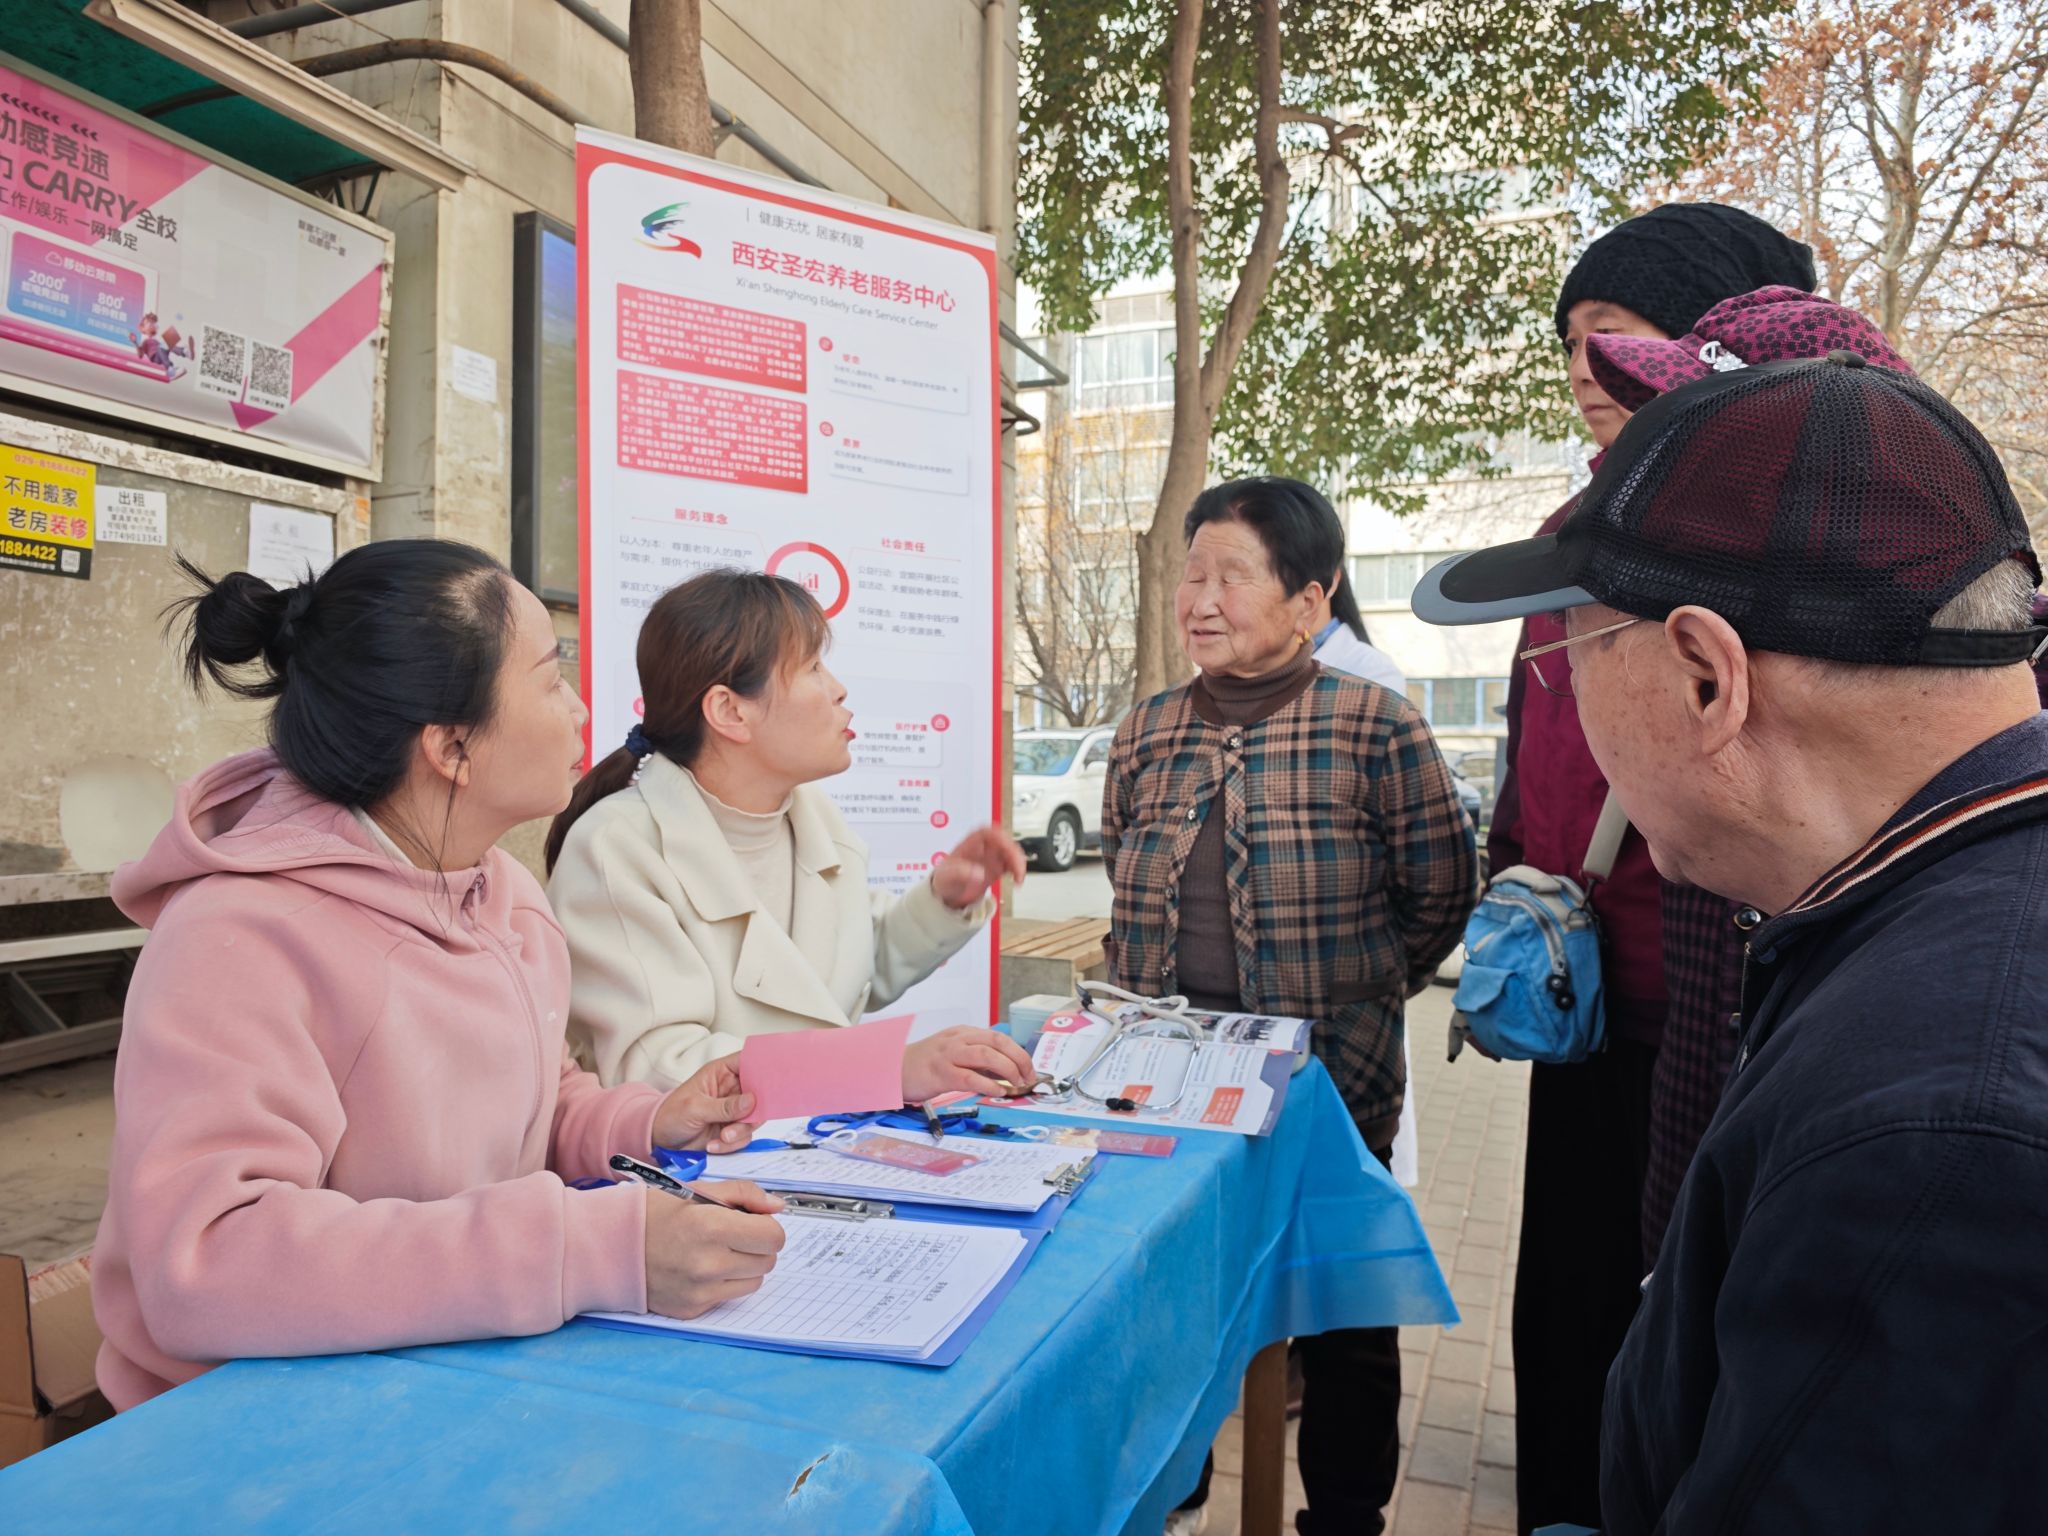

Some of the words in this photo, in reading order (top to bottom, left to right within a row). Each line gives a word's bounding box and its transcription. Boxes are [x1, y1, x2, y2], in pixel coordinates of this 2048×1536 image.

[74, 217, 138, 251] 一网搞定
[759, 210, 810, 236] 健康无忧
[816, 224, 865, 250] 居家有爱
[731, 240, 957, 314] 西安圣宏养老服务中心
[763, 282, 818, 306] Shenghong
[820, 295, 851, 315] Elderly
[852, 303, 873, 318] Care
[875, 309, 907, 326] Service
[908, 315, 939, 331] Center
[3, 475, 79, 508] 不用搬家
[118, 490, 146, 507] 出租
[8, 506, 88, 540] 老房装修
[674, 508, 729, 525] 服务理念
[881, 537, 926, 553] 社会责任
